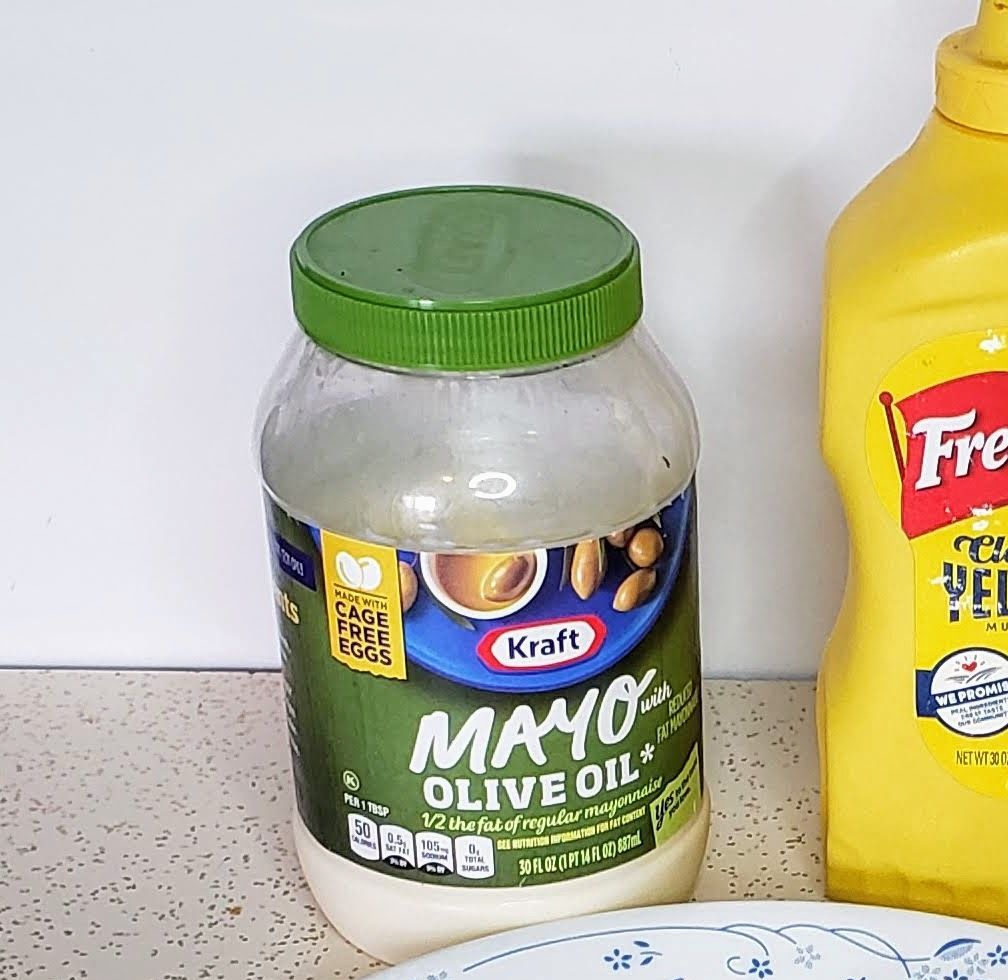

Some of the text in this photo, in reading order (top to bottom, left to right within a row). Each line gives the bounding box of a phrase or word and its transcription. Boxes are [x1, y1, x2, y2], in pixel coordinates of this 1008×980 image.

[335, 588, 388, 611] MADE WITH
[335, 600, 389, 629] CAGE
[337, 617, 390, 648] FREE
[508, 629, 580, 660] Kraft
[339, 636, 393, 667] EGGS
[935, 694, 958, 707] WE
[408, 668, 657, 774] MAYO
[640, 680, 673, 714] with
[956, 750, 973, 766] NET
[989, 751, 1000, 766] 30
[343, 792, 361, 809] PER
[367, 802, 390, 818] TBSP
[421, 811, 446, 830] 1/2
[448, 815, 477, 832] the
[476, 816, 504, 835] fat
[504, 814, 523, 835] of
[522, 809, 583, 835] regular
[584, 776, 663, 818] mayonnaise
[422, 772, 567, 812] OLIVE
[655, 790, 676, 832] Yes
[354, 818, 371, 839] 50
[464, 855, 485, 864] TOTAL
[518, 859, 532, 876] 30
[533, 856, 544, 874] FL
[544, 854, 558, 873] OZ
[568, 849, 579, 869] PT
[580, 847, 591, 866] 14
[592, 844, 602, 862] FL
[602, 840, 617, 859] OZ)
[617, 830, 642, 854] 887mL
[461, 865, 490, 873] SUGARS
